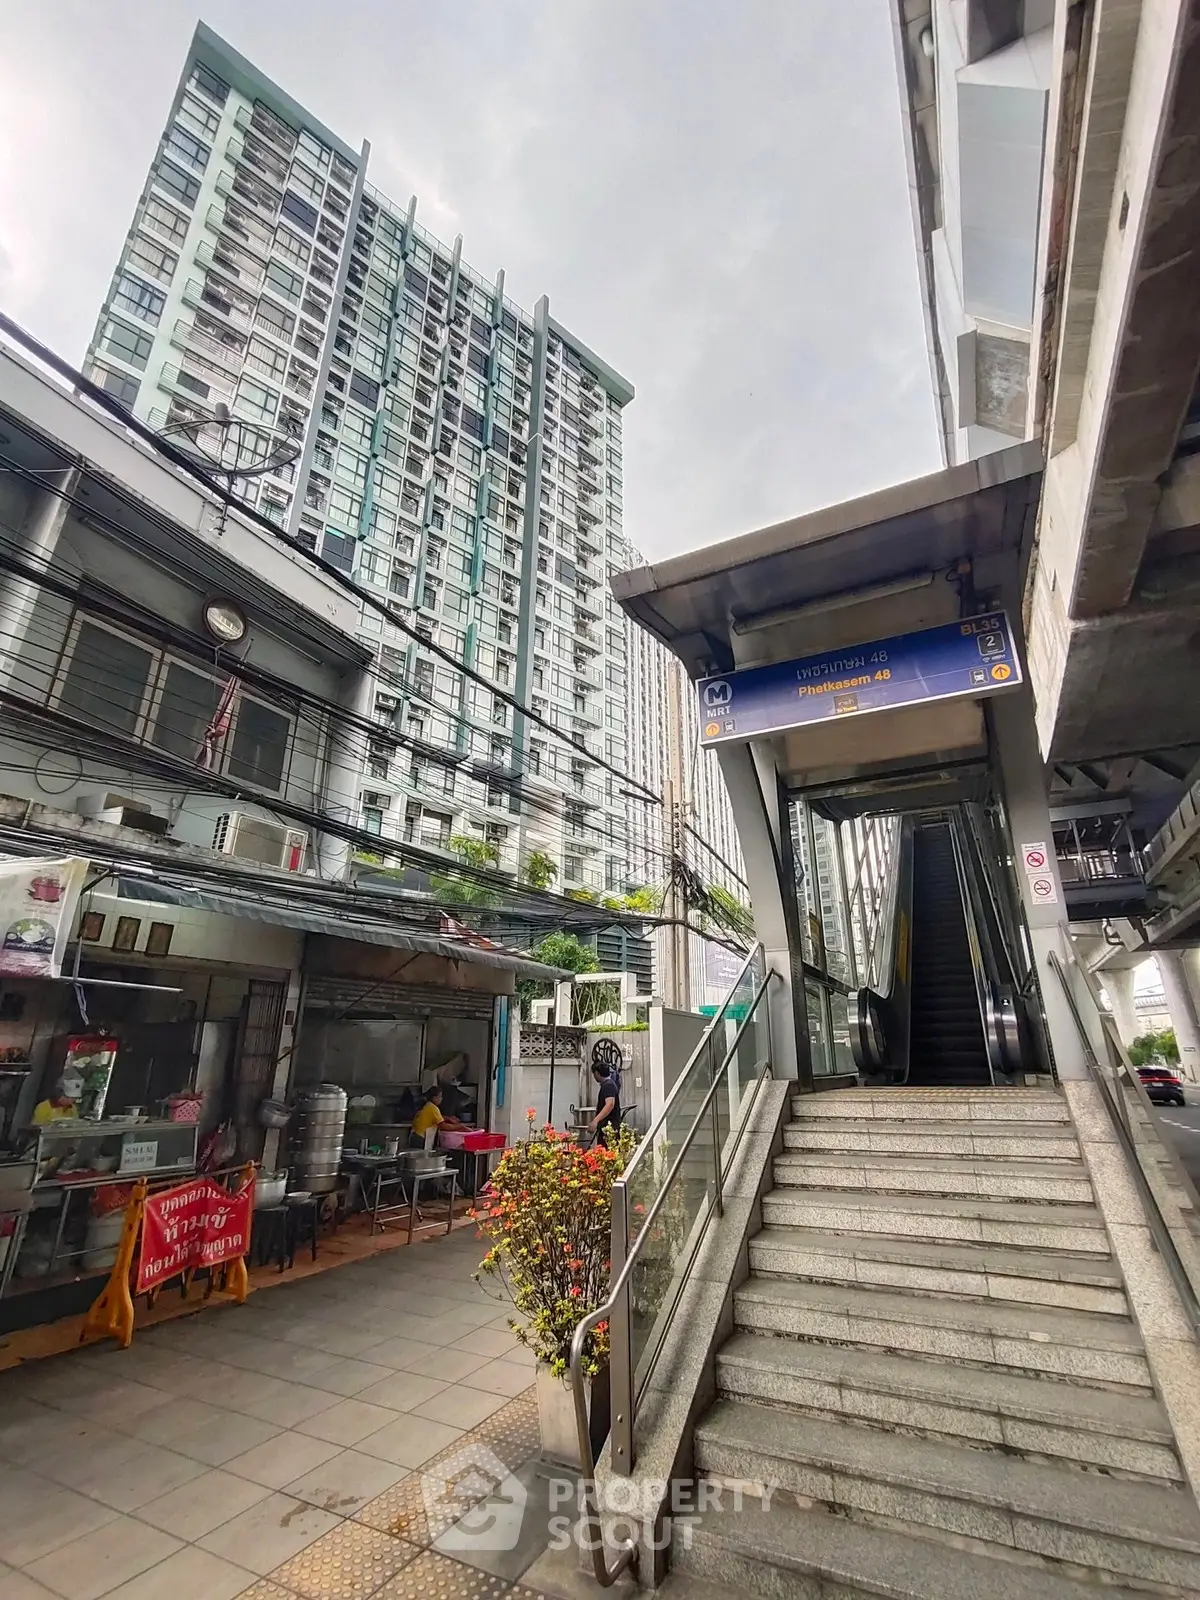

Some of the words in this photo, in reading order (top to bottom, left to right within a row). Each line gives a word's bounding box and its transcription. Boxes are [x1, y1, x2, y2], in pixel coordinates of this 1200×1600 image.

[961, 618, 1000, 636] BL35
[986, 636, 996, 647] 2
[796, 656, 865, 680] เพชรเกษม
[870, 650, 889, 663] 48
[798, 675, 871, 697] Phetkasem
[874, 669, 891, 681] 48
[706, 705, 731, 718] MRT
